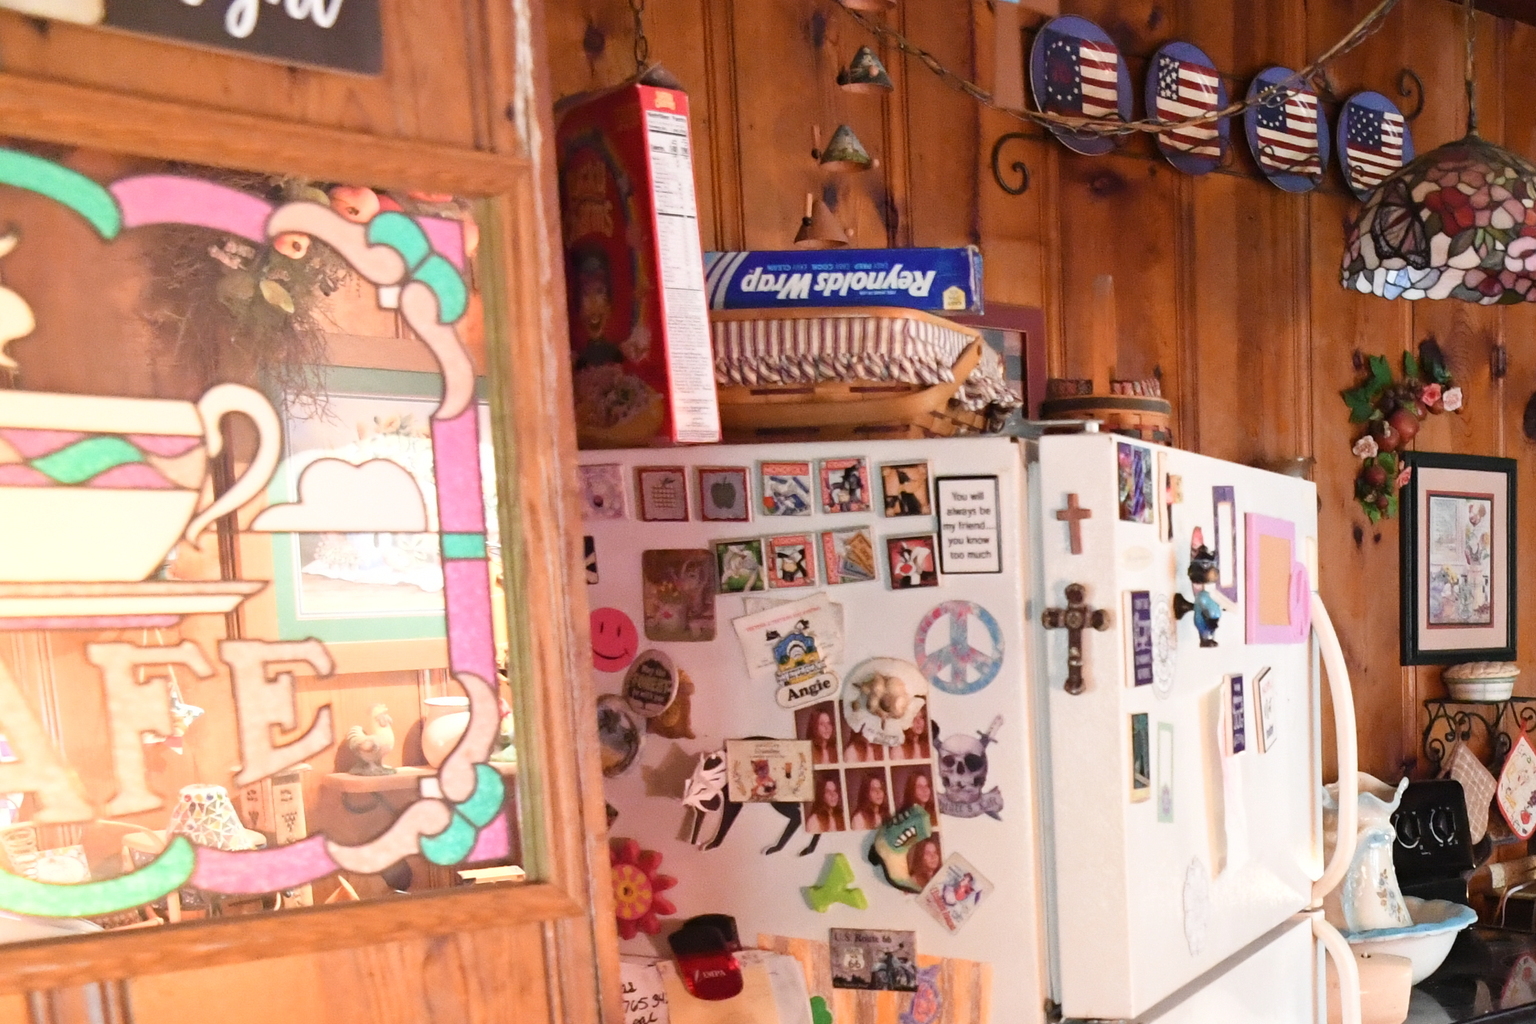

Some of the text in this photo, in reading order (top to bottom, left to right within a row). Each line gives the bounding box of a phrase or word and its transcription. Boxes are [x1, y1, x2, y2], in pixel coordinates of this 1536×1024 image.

[740, 267, 813, 300] Wrap
[813, 263, 936, 298] Reynolds
[951, 491, 985, 501] You will
[946, 507, 991, 518] always be
[943, 523, 956, 533] my
[948, 536, 990, 547] you know
[967, 551, 991, 559] much
[787, 679, 831, 701] Angie
[854, 933, 879, 943] Route
[882, 935, 892, 943] 66
[848, 960, 861, 969] 66
